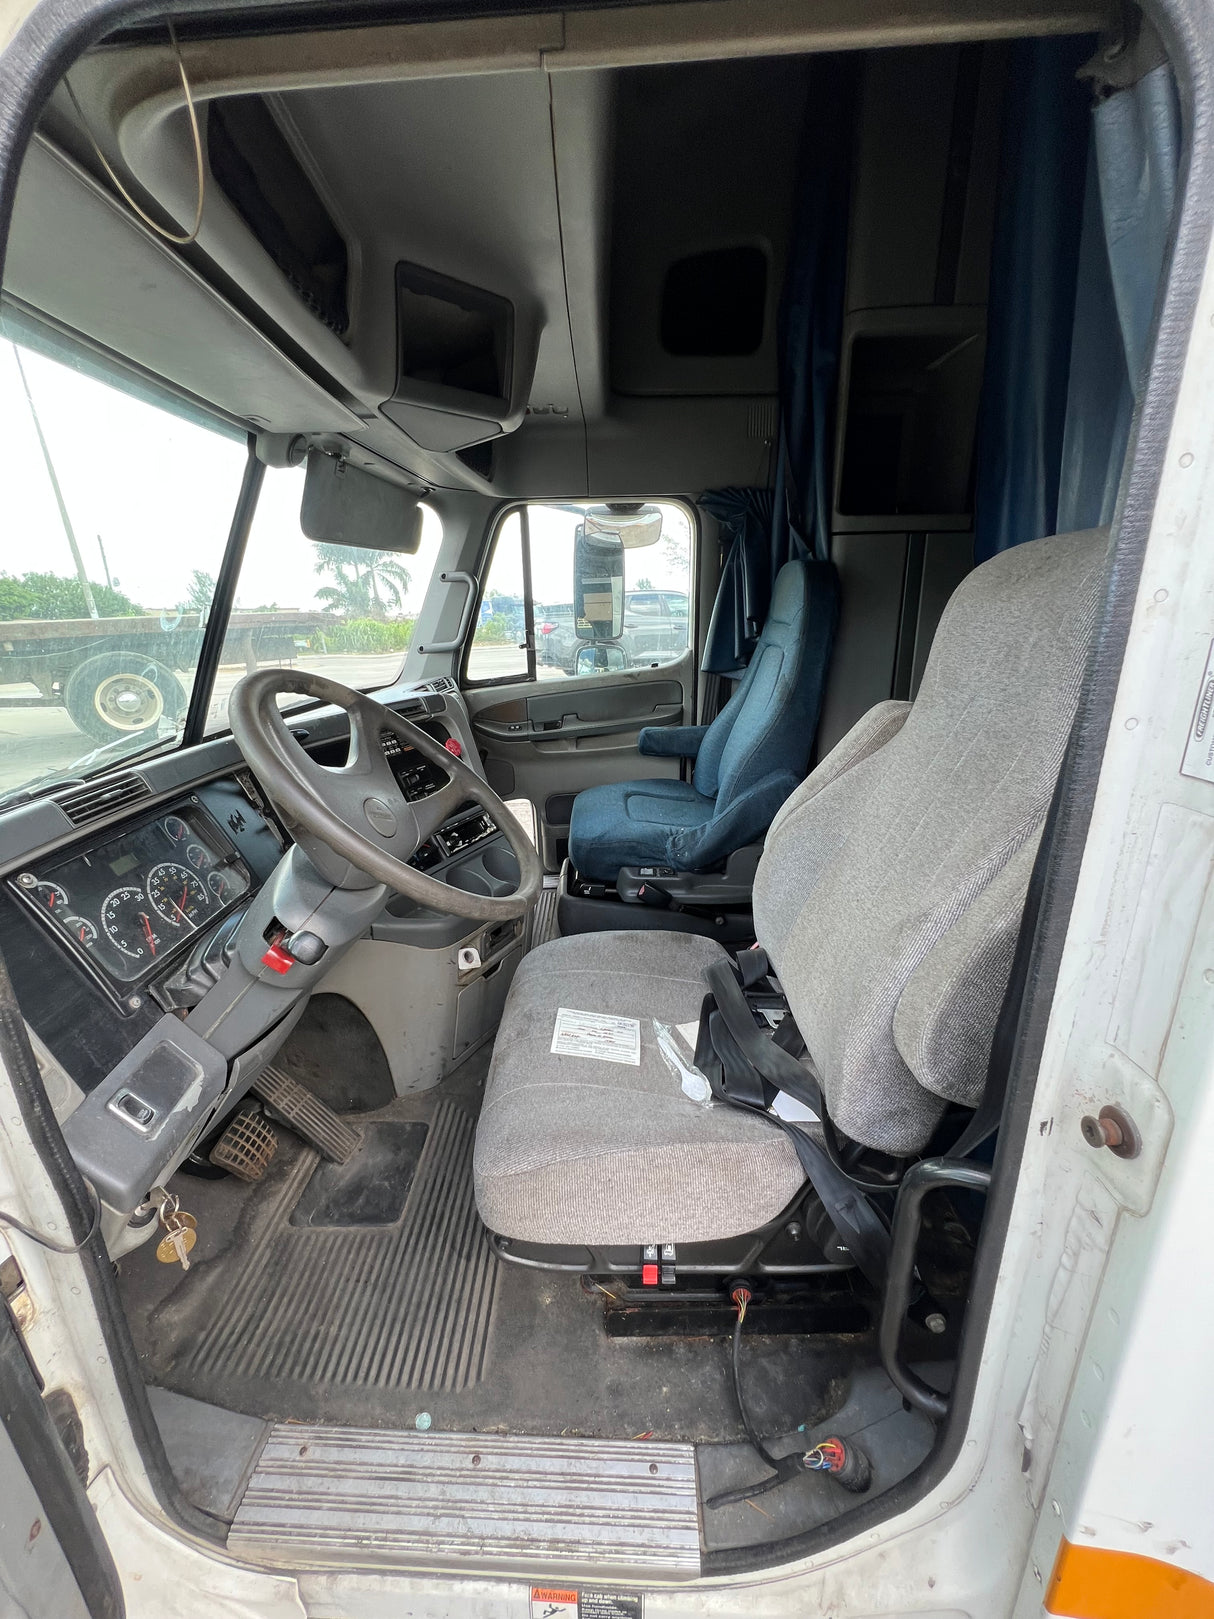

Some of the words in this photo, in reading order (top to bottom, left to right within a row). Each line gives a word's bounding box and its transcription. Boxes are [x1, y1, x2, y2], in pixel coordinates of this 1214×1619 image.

[1197, 682, 1214, 736] FREIGHTLINER
[120, 891, 131, 901] 25
[134, 892, 145, 902] 30
[151, 889, 161, 898] 25
[110, 897, 121, 908] 20
[158, 902, 166, 911] 15
[106, 910, 116, 920] 15
[108, 925, 119, 934] 10
[120, 939, 128, 948] 5
[136, 947, 144, 955] 0
[541, 1589, 576, 1601] WARNING
